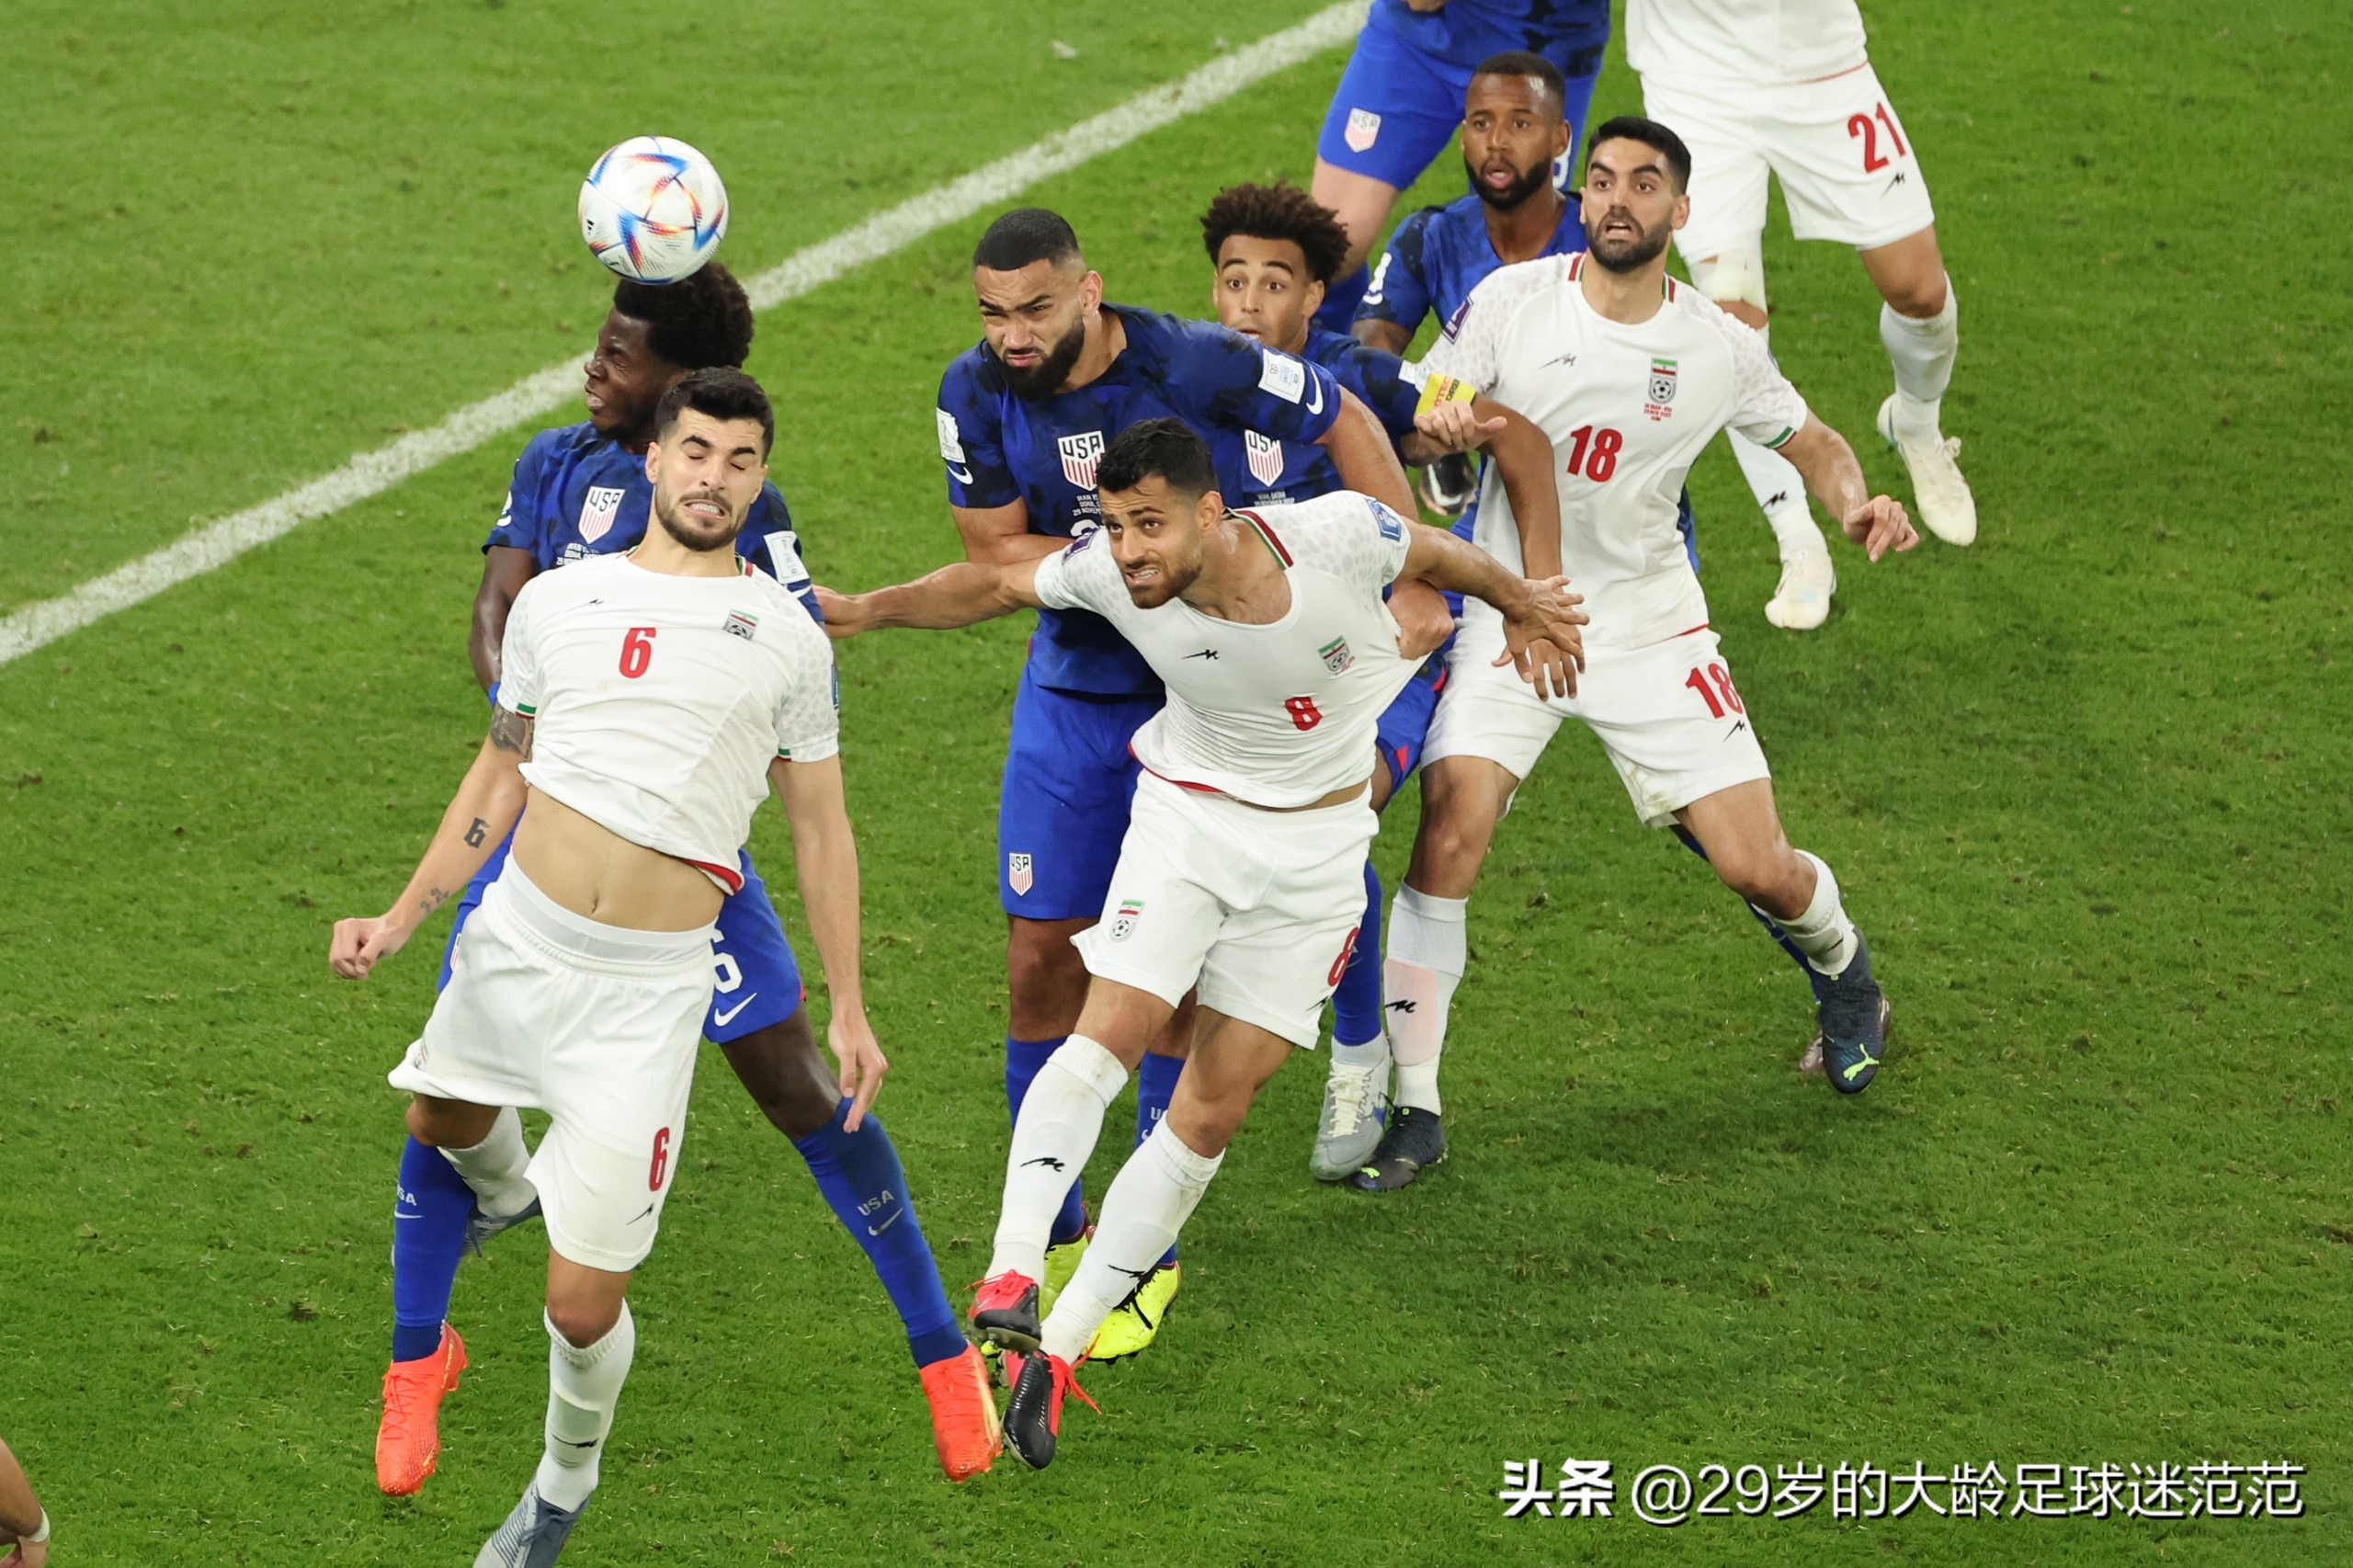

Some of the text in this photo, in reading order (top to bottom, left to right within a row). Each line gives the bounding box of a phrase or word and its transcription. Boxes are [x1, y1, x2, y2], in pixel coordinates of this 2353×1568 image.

[1847, 101, 1906, 174] 21
[1062, 434, 1101, 460] USA
[1567, 425, 1623, 483] 18
[589, 489, 620, 512] USA
[619, 627, 656, 678] 6
[1685, 663, 1743, 719] 18
[1284, 696, 1323, 731] 8
[1011, 855, 1029, 871] USA
[1327, 926, 1360, 987] 8
[649, 1127, 670, 1192] 6
[397, 1182, 417, 1206] SA
[857, 1189, 894, 1216] USA
